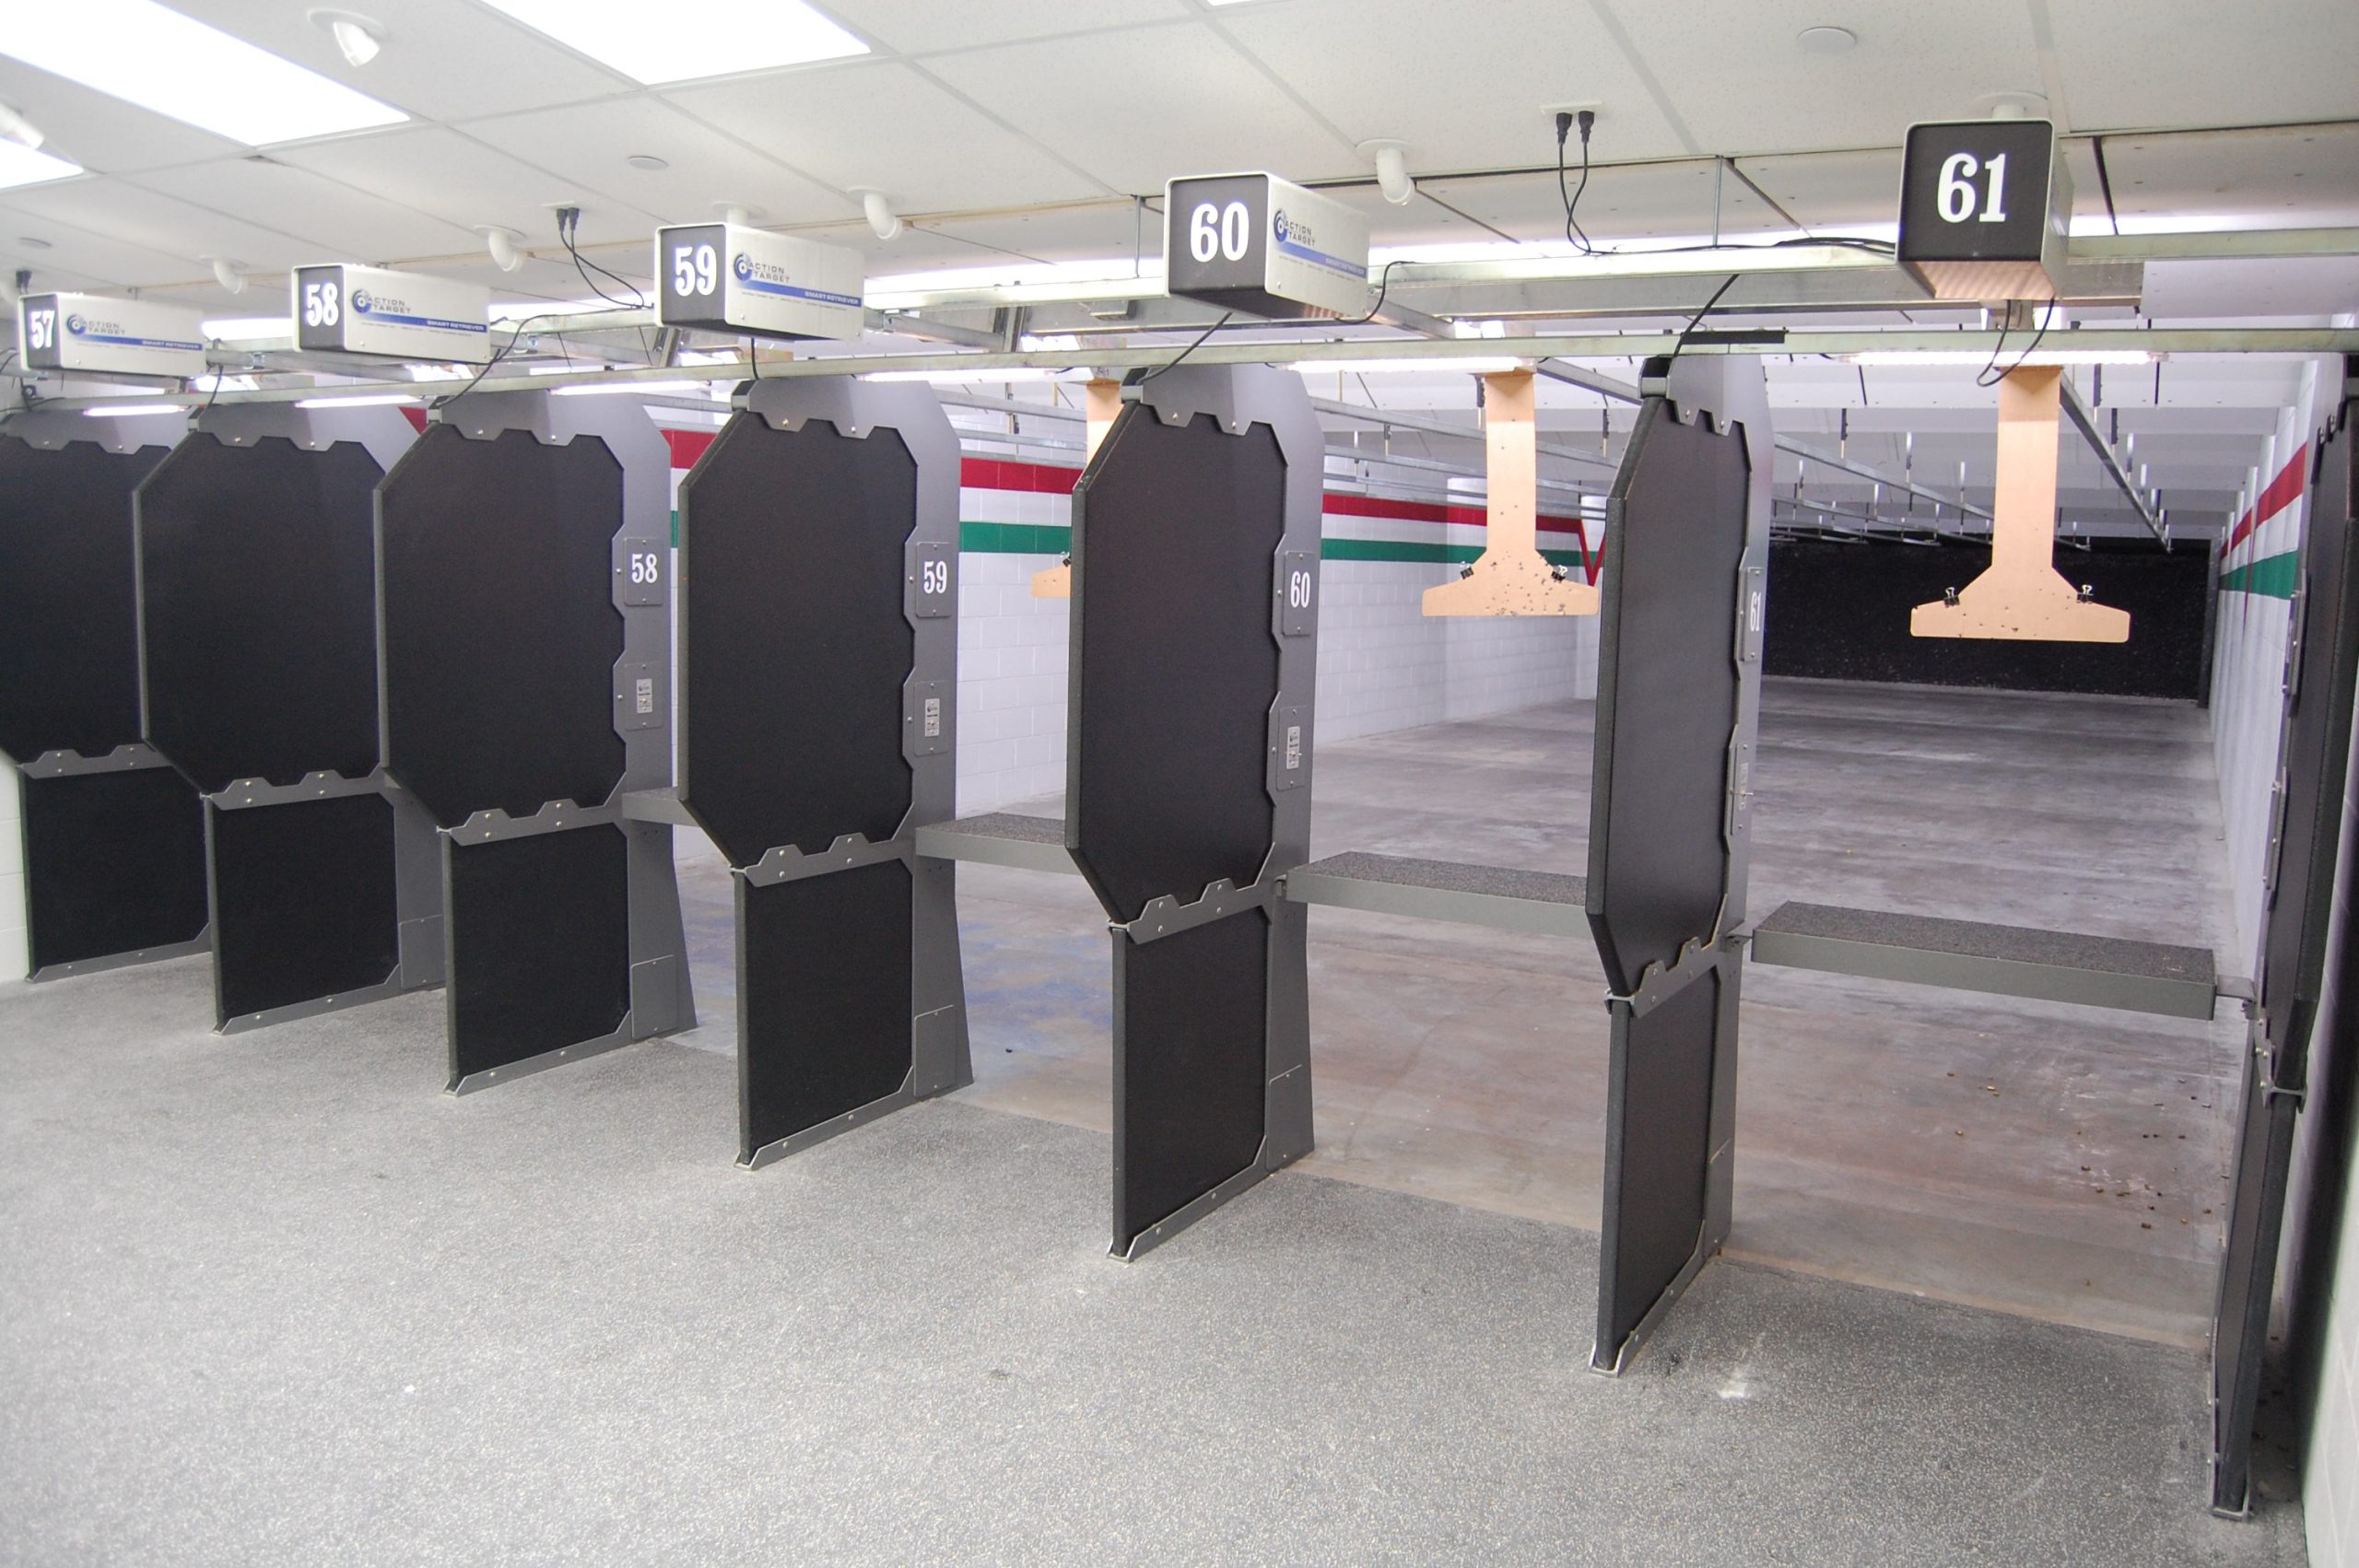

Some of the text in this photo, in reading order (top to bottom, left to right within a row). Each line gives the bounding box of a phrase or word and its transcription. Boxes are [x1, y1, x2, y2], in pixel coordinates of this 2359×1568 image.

[1937, 152, 2007, 223] 61
[1190, 201, 1250, 263] 60
[1285, 220, 1312, 236] ACTION
[1289, 231, 1316, 247] TARGET
[675, 244, 717, 297] 59
[748, 262, 785, 275] ACTION
[754, 271, 791, 283] TARGET
[306, 282, 339, 327] 58
[368, 296, 405, 307] ACTION
[373, 303, 412, 314] TARGET
[804, 290, 827, 301] SMART
[827, 294, 860, 306] RETRIEVER
[29, 310, 55, 349] 57
[82, 320, 120, 329] ACTION
[88, 326, 126, 335] TARGET
[631, 553, 658, 584] 58
[923, 560, 948, 594] 59
[1290, 570, 1311, 608] 60
[1751, 591, 1763, 632] 61
